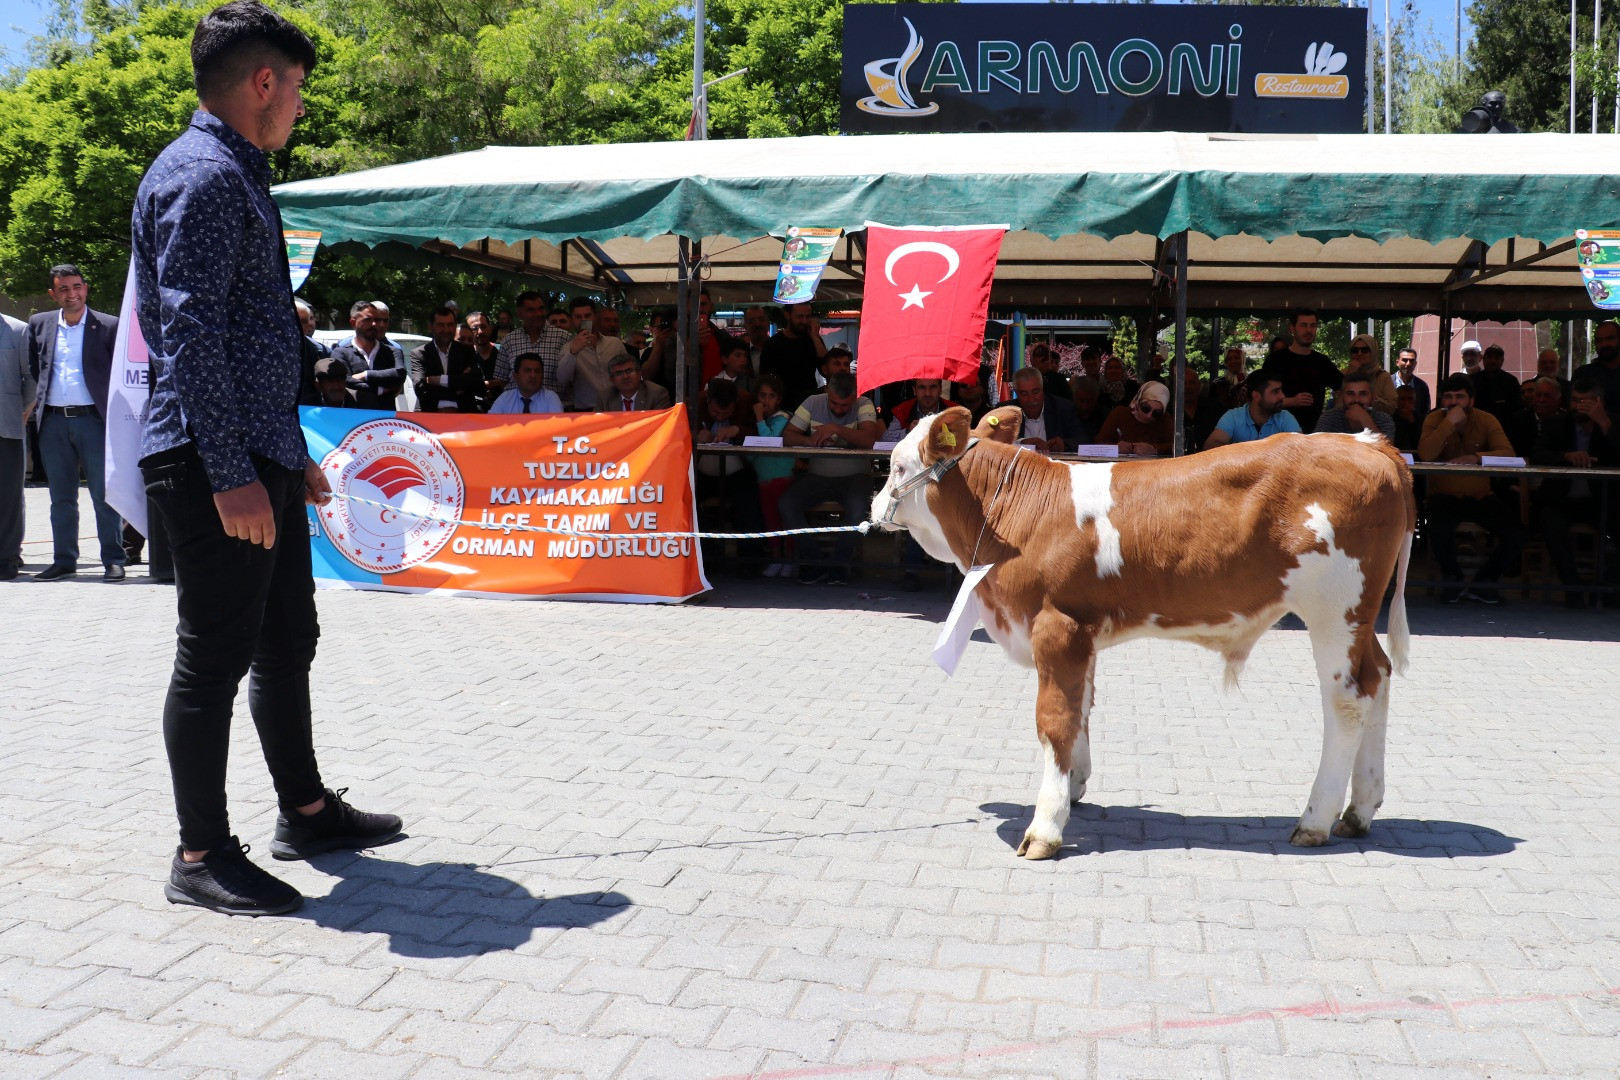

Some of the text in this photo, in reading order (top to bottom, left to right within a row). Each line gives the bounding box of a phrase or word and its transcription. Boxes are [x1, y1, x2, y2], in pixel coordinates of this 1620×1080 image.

[876, 80, 895, 94] CAFE
[1262, 76, 1344, 93] Restaurant
[552, 436, 597, 454] T.C.
[338, 446, 380, 494] CUMHURİYETİ
[381, 445, 406, 455] TARIM
[408, 450, 419, 460] VE
[419, 459, 440, 491] ORMAN
[523, 461, 630, 480] TUZLUCA
[490, 481, 663, 506] KAYMAKAMLIĞI
[480, 508, 657, 535] İLÇE TARIM VE
[452, 537, 535, 557] ORMAN
